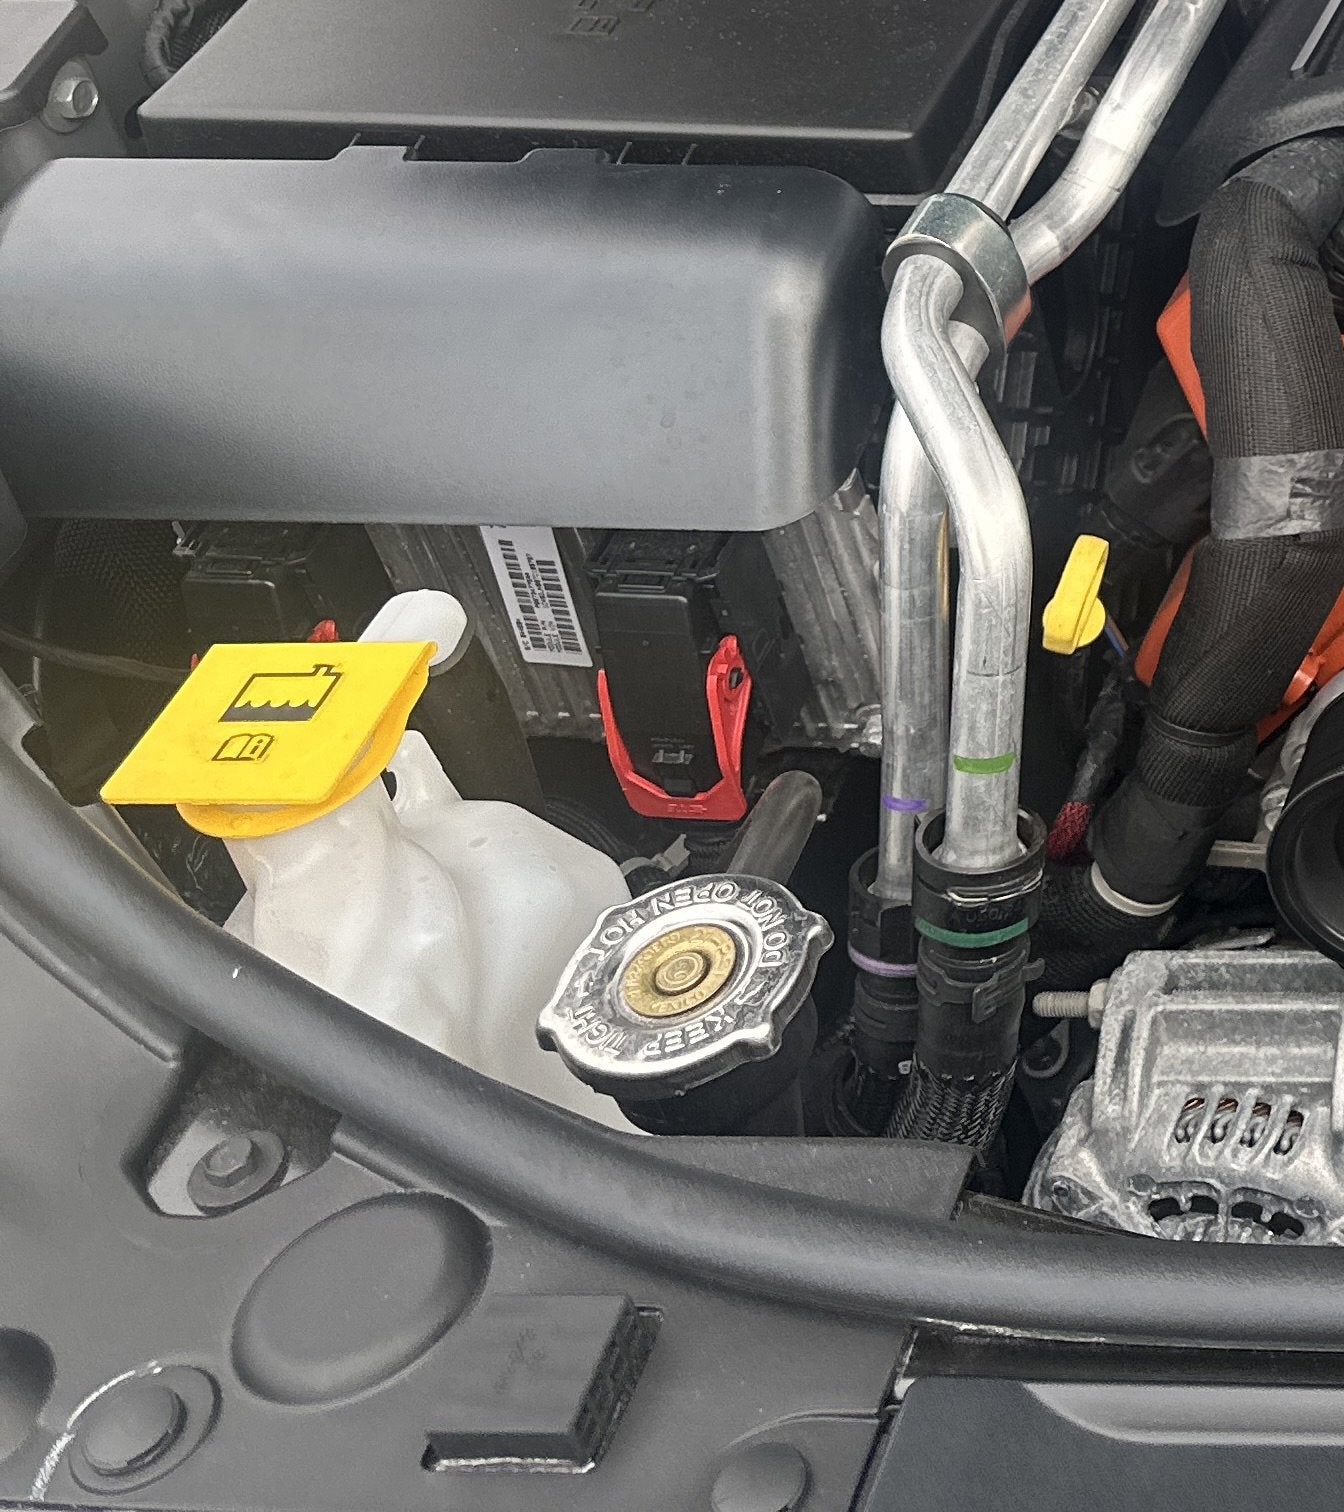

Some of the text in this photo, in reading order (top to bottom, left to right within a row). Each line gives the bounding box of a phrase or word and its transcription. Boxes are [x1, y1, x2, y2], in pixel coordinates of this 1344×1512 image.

[588, 880, 788, 968] DO NOT OPEN HOT
[640, 1007, 736, 1060] KEEP
